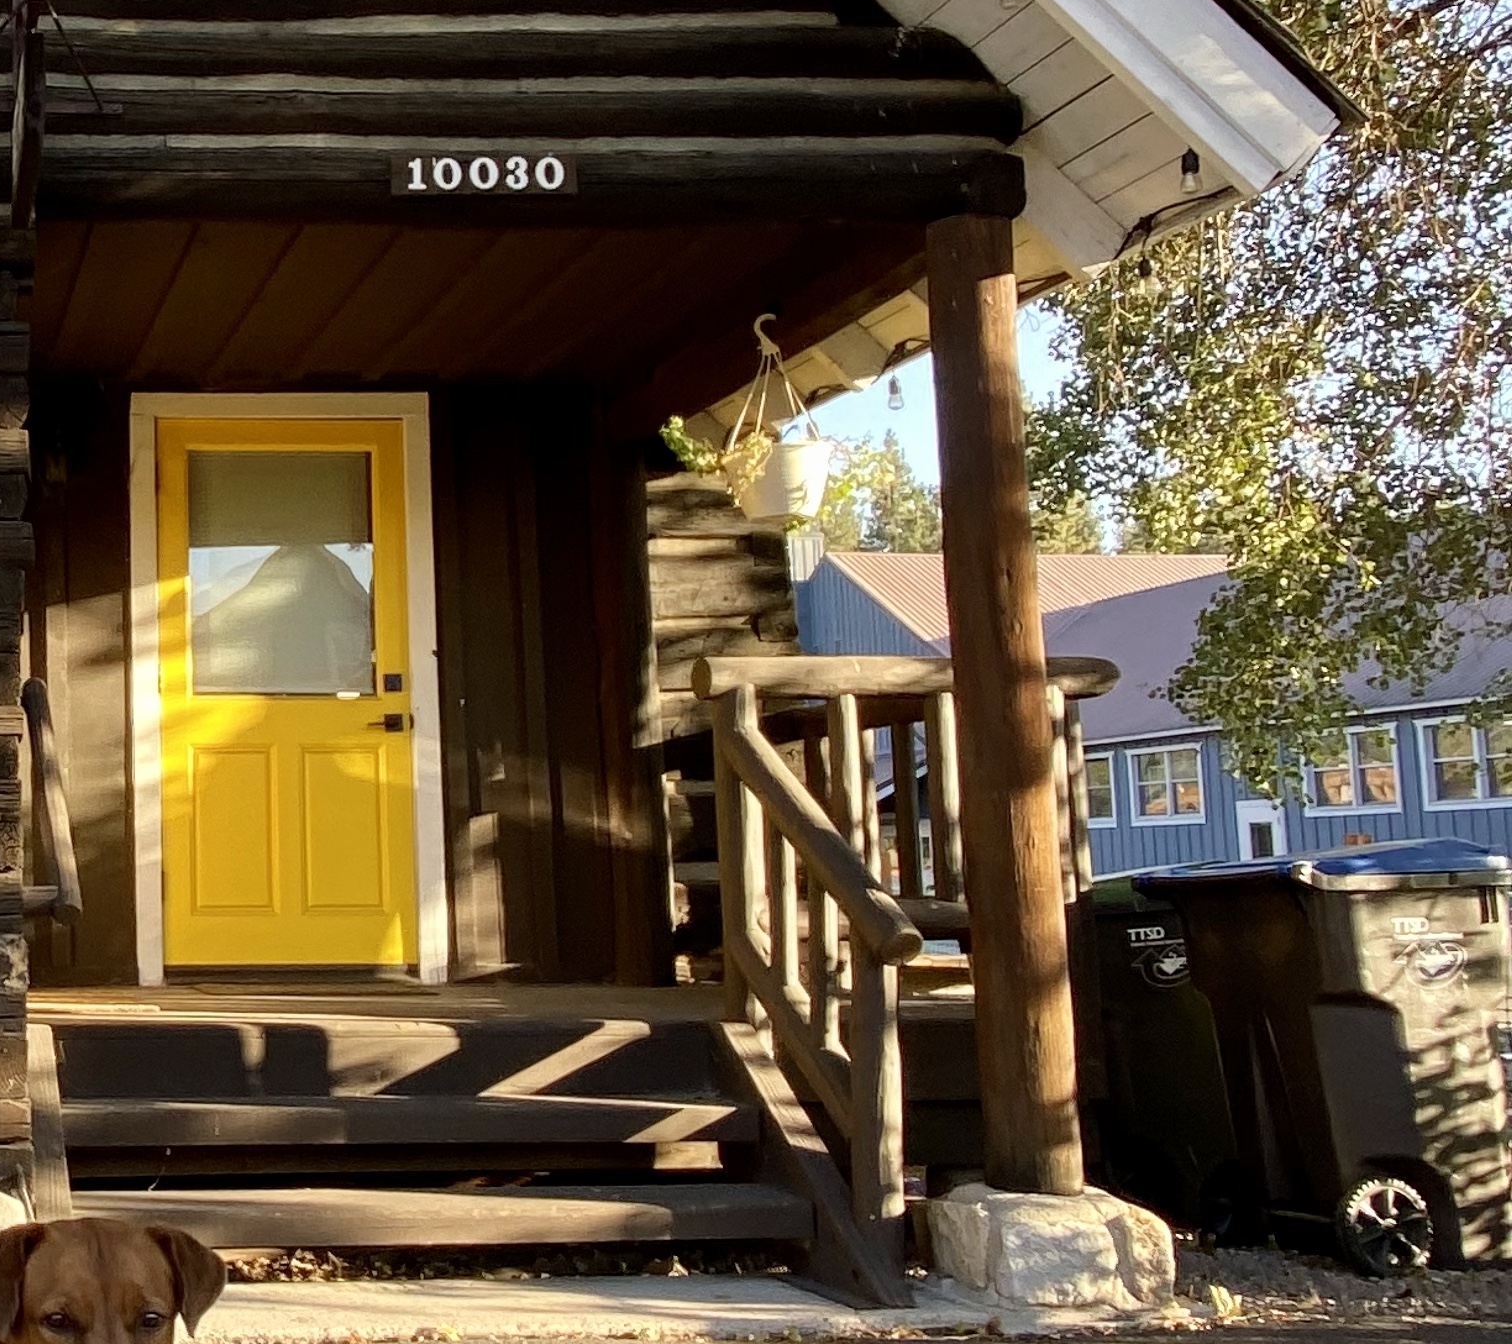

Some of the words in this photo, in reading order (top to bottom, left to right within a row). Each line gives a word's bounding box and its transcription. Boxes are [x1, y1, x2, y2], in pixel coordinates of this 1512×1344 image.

[407, 156, 565, 190] 10030
[1390, 917, 1430, 933] TTSD
[1126, 926, 1166, 941] TTSD
